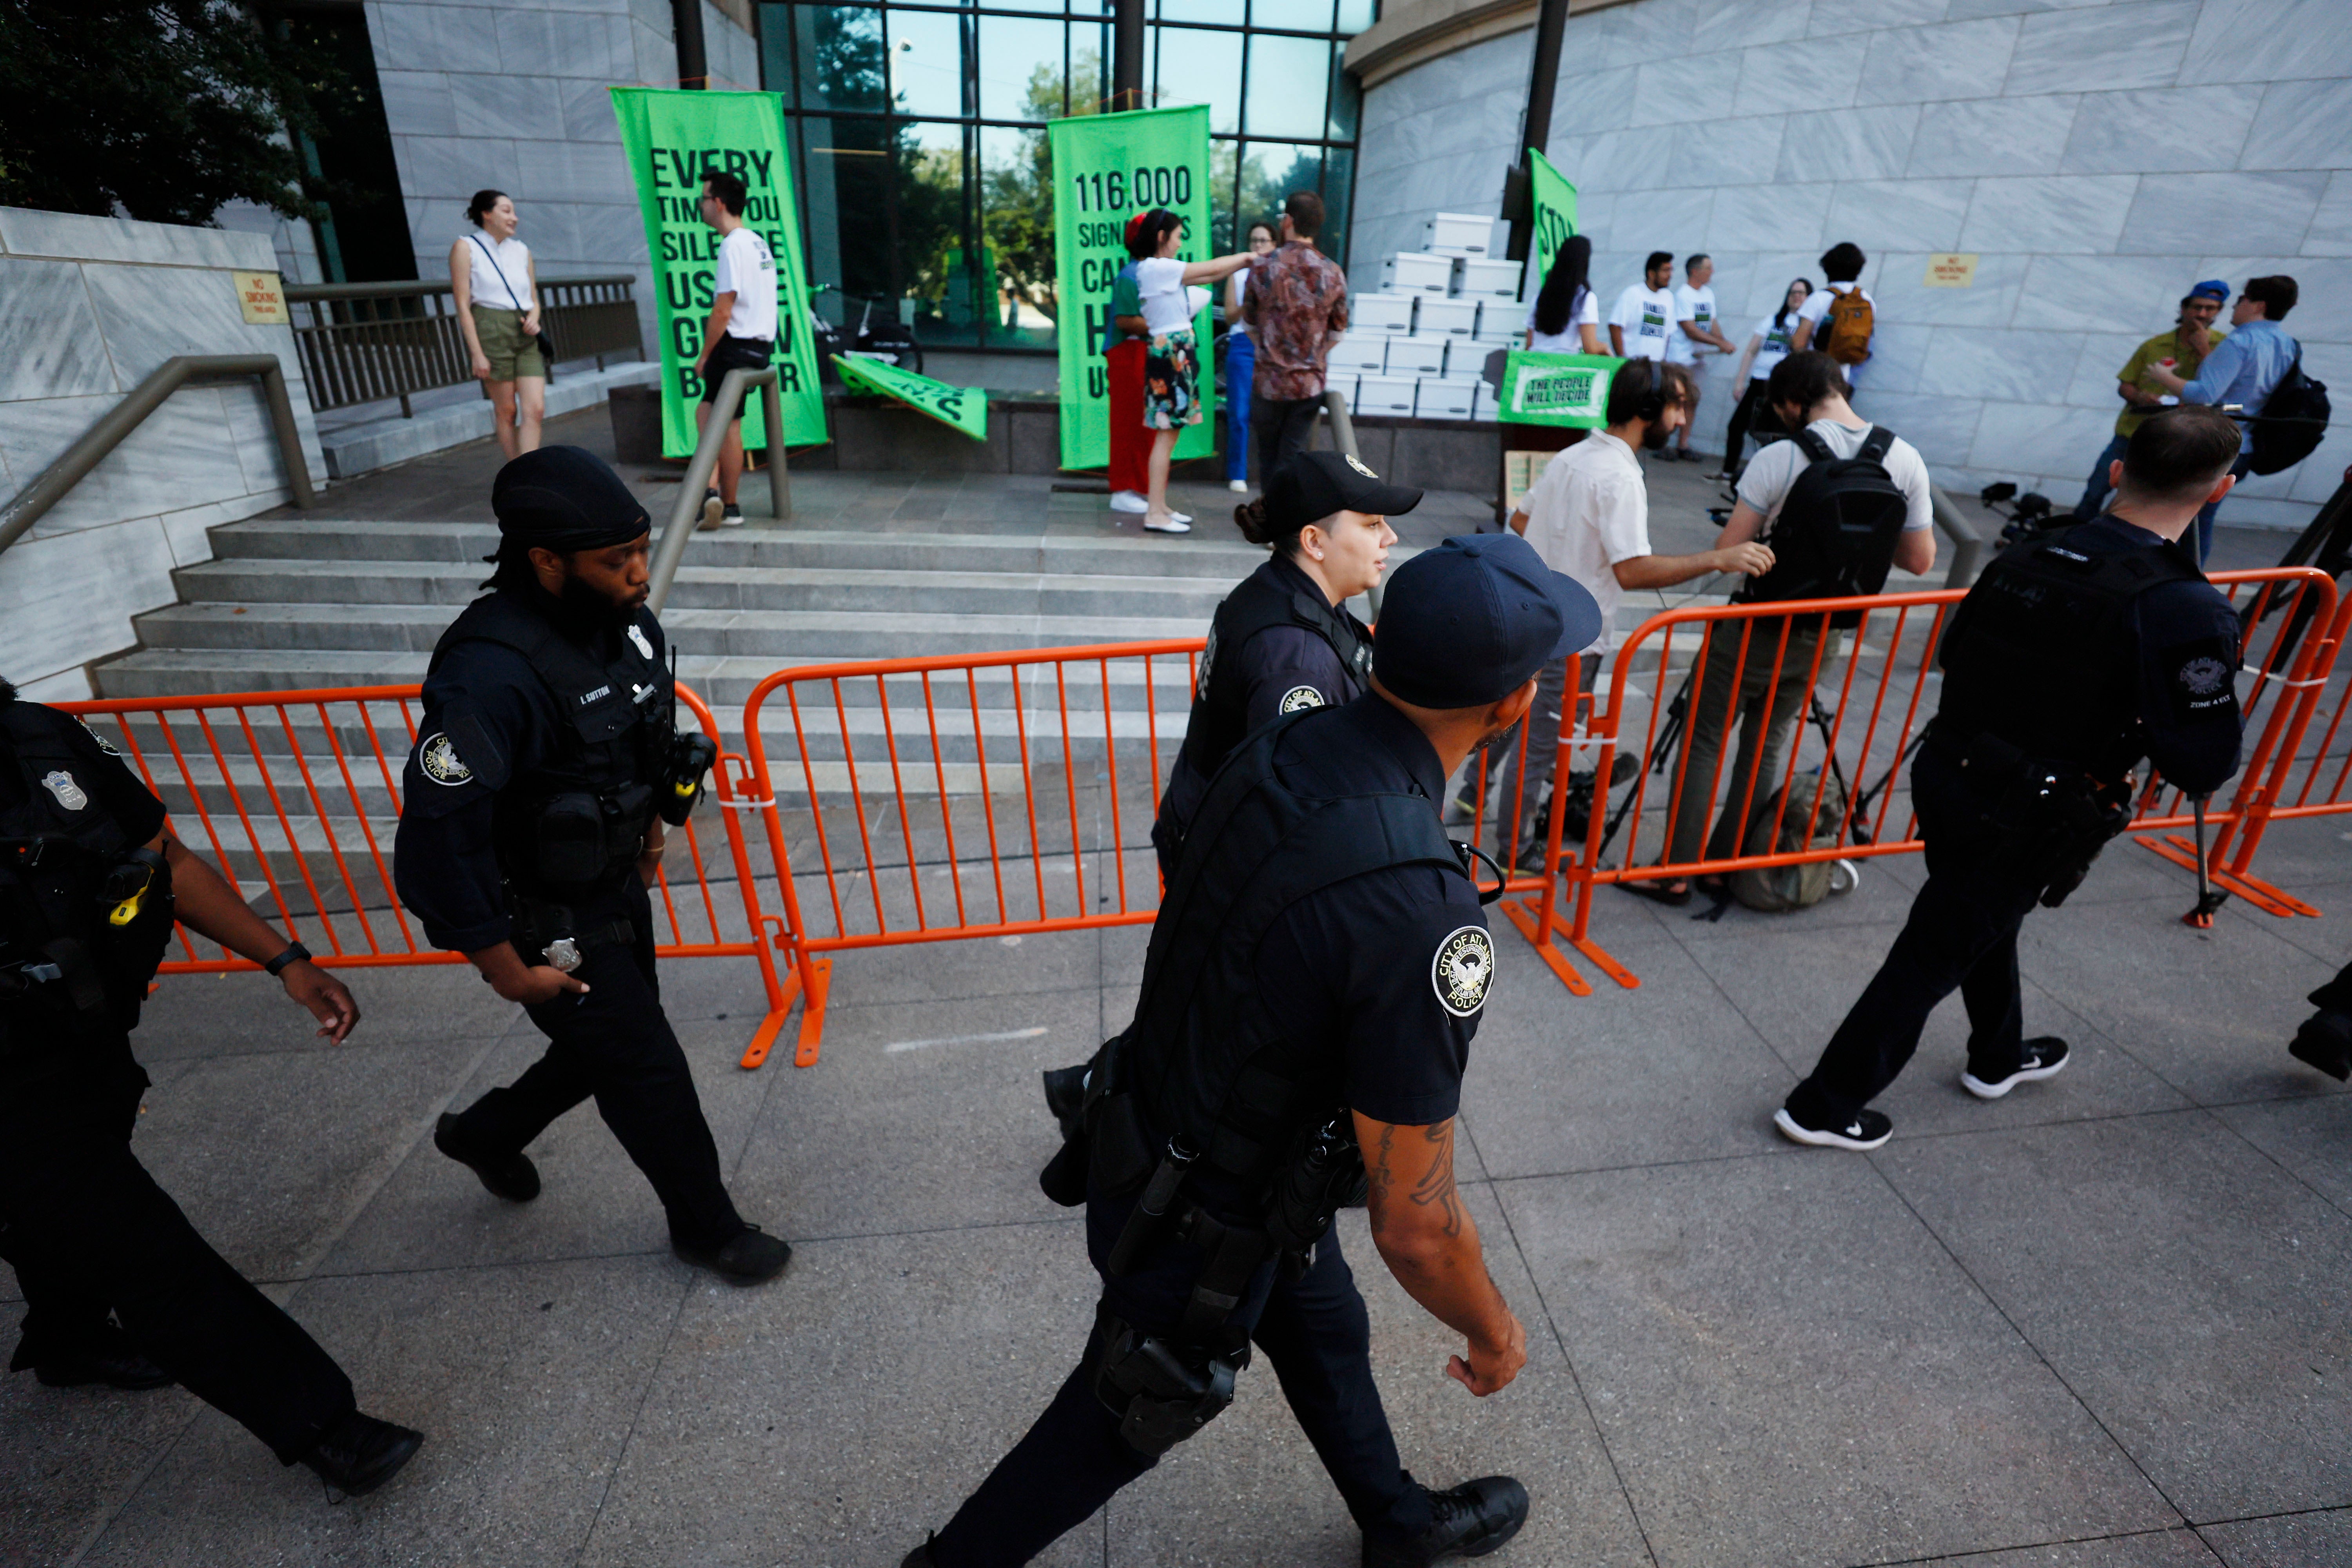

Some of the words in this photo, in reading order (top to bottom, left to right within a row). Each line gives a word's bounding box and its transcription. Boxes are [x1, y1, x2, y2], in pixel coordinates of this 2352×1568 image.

[651, 149, 772, 188] EVERY
[1076, 165, 1191, 212] 116,000
[656, 196, 706, 223] TIM
[745, 196, 780, 221] OU
[1535, 201, 1574, 255] STO
[661, 229, 784, 261] SILEE
[586, 685, 610, 702] SUTTON
[1284, 697, 1293, 713] CITY
[1292, 690, 1303, 699] OF
[2190, 700, 2211, 708] ZONE
[426, 750, 447, 780] POLICE
[1439, 948, 1454, 976] CITY
[1453, 935, 1467, 949] OF
[1470, 933, 1491, 974] ATLANTA
[1447, 989, 1483, 1008] POLICE
